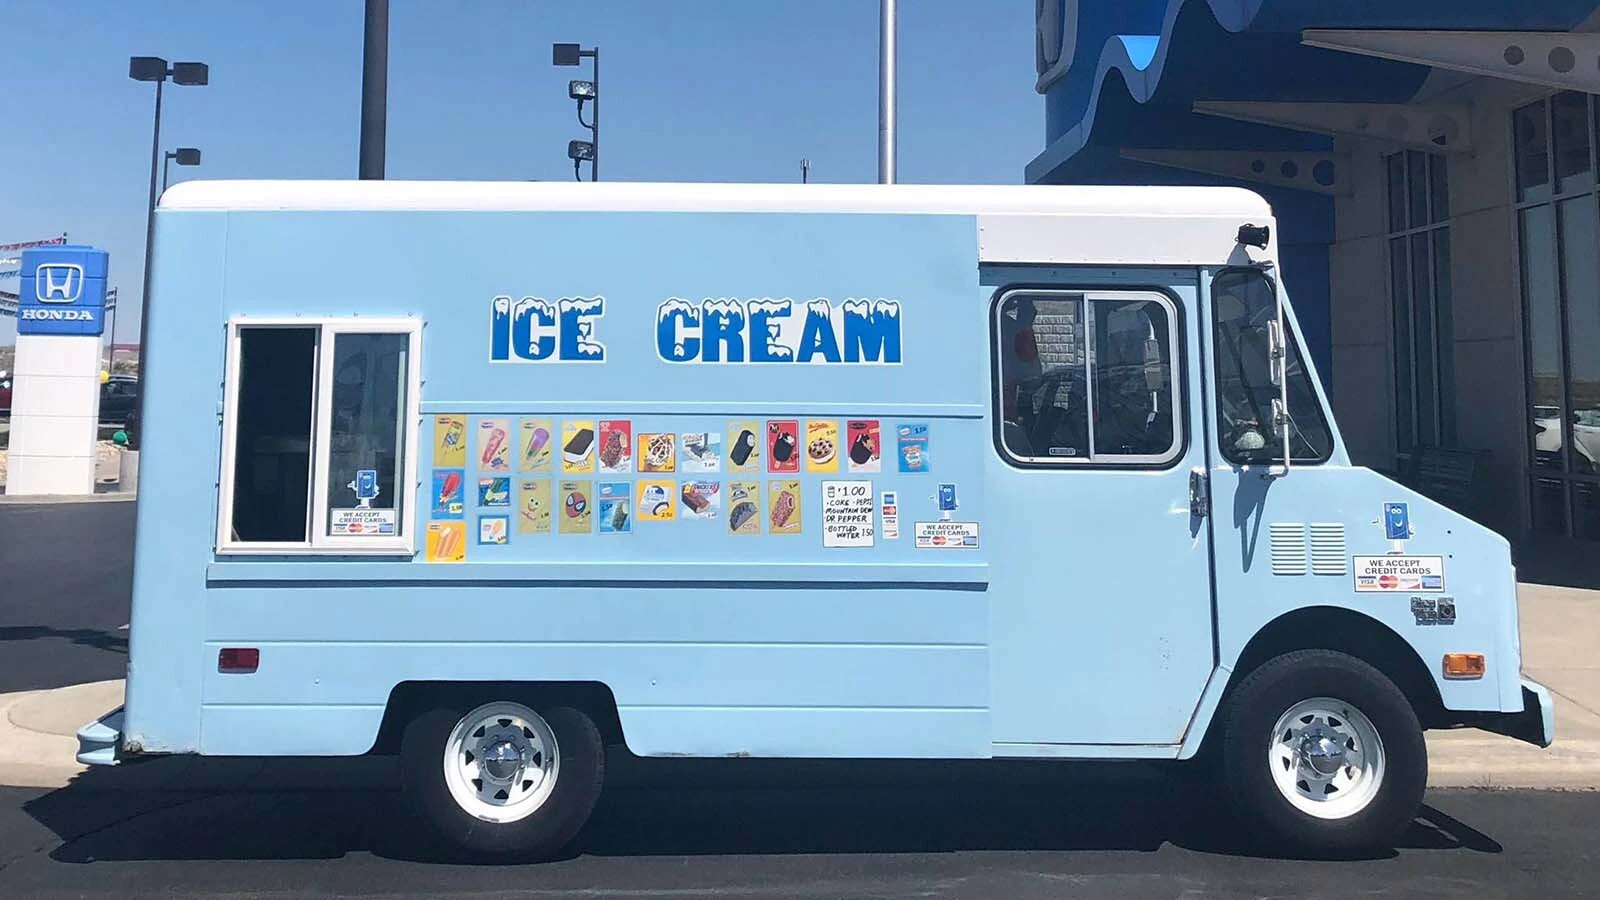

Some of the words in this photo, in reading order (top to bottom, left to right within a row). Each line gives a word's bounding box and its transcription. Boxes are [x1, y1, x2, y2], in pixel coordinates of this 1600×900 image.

[21, 309, 94, 320] HONDA
[490, 296, 606, 364] ICE
[656, 297, 903, 366] CREAM
[826, 515, 836, 523] DR
[837, 515, 868, 523] PEPPER
